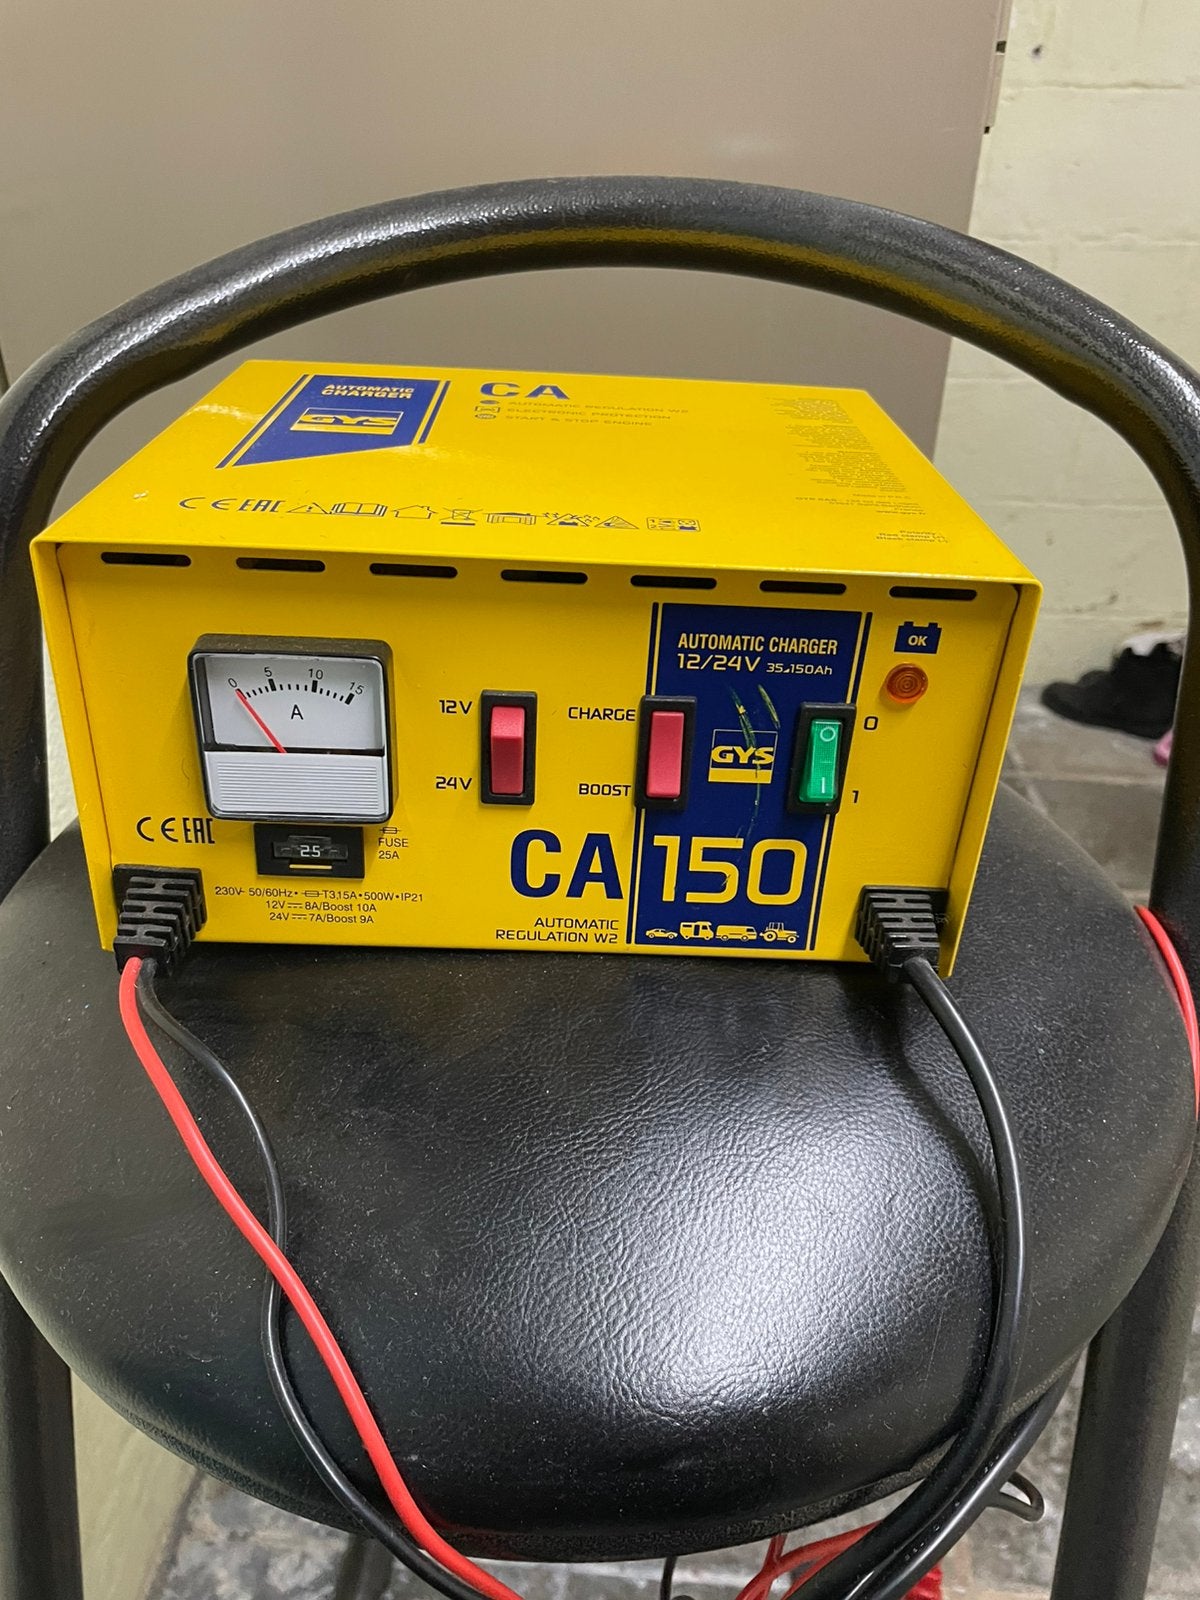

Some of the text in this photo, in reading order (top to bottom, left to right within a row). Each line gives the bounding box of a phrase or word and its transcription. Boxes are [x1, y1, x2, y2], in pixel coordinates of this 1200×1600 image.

[321, 389, 412, 399] CHARGER
[324, 384, 414, 393] AUTOMATIC
[480, 382, 570, 399] CA
[299, 414, 398, 427] GYS
[678, 633, 838, 655] AUTOMATIC CHARGER
[907, 634, 928, 647] OK
[677, 653, 761, 672] 12/24V
[228, 667, 364, 696] 0 5 10 15
[290, 704, 304, 720] A
[439, 700, 473, 714] 12V
[568, 706, 636, 722] CHARGE
[711, 745, 775, 765] GYS
[435, 776, 473, 790] 24V
[578, 783, 632, 797] BOOST
[378, 837, 409, 848] FUSE
[300, 844, 321, 858] 25
[378, 850, 400, 860] 25A
[510, 828, 807, 905] CA 150
[265, 900, 378, 913] 12V 8A/Boost 10A
[269, 912, 375, 924] 24V 7A/Boost 9A
[534, 917, 619, 930] AUTOMATIC
[495, 928, 619, 944] REGULATION W2
